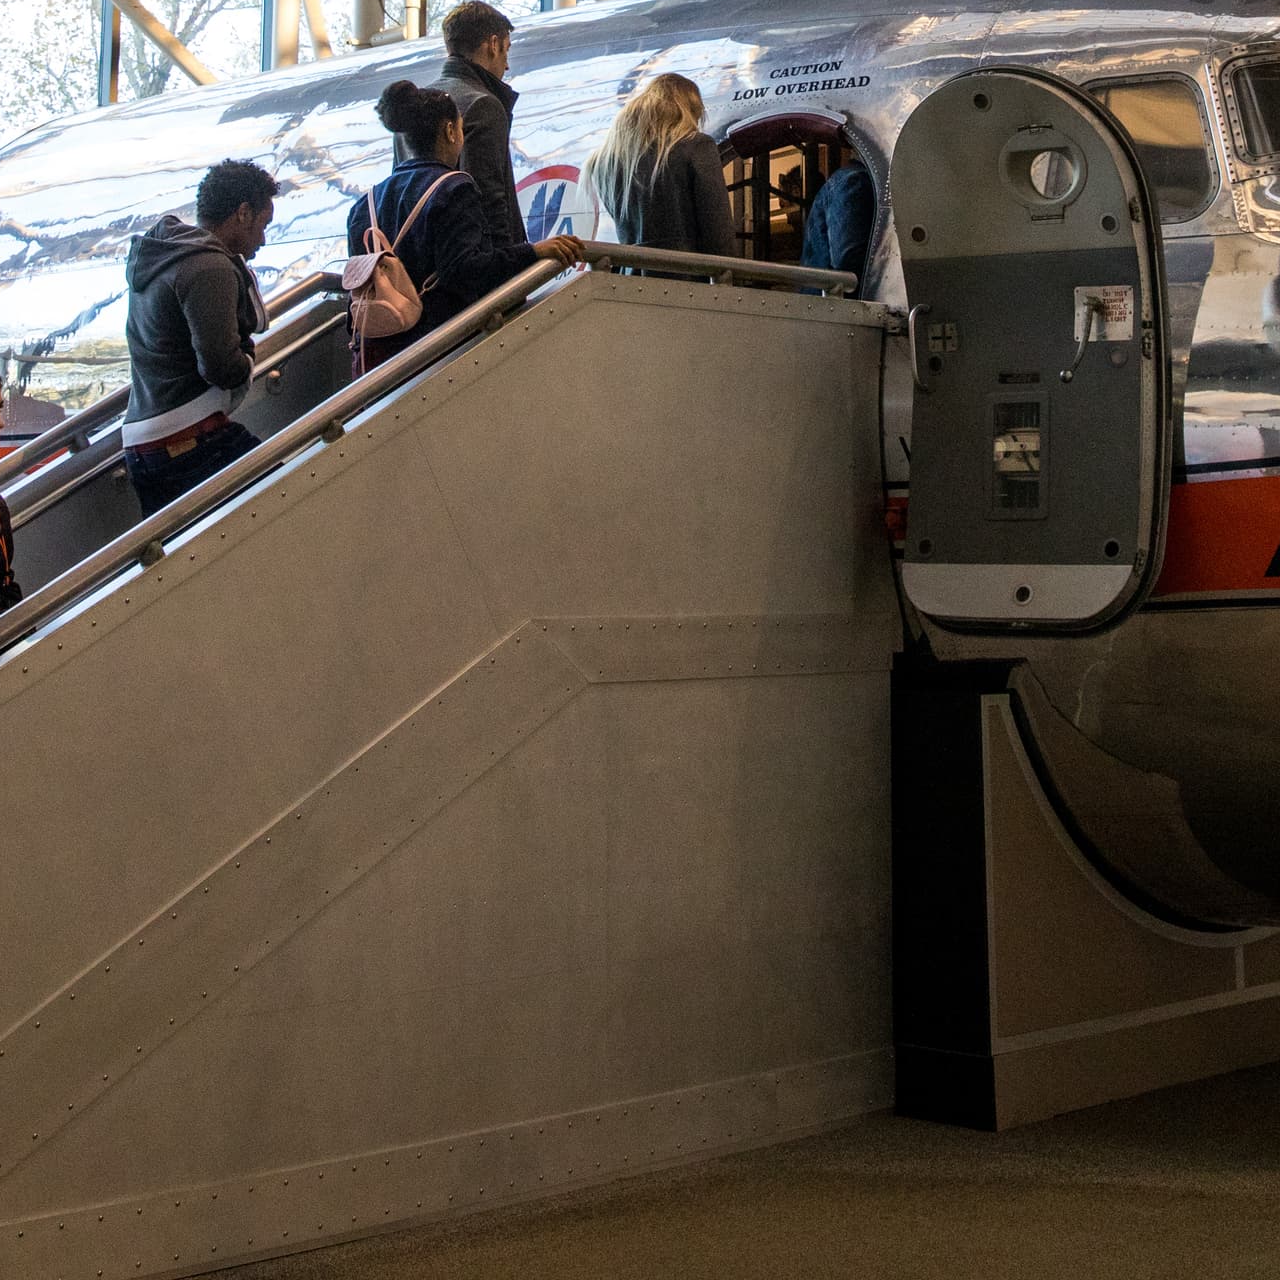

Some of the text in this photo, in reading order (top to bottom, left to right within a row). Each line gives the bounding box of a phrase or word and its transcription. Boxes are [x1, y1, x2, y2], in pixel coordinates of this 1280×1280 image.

[770, 60, 843, 79] CAUTION
[732, 75, 871, 102] LOW OVERHEAD
